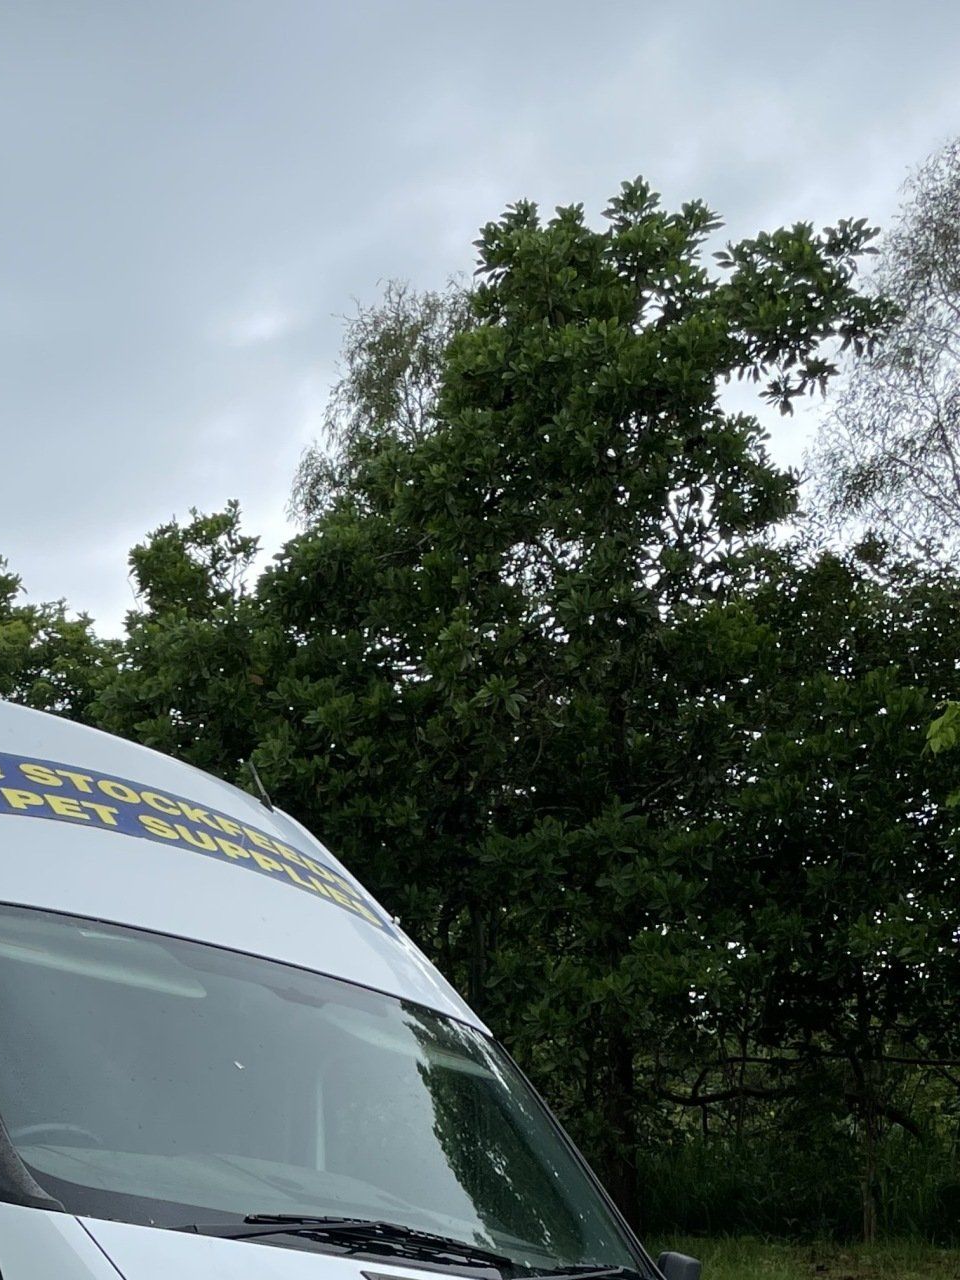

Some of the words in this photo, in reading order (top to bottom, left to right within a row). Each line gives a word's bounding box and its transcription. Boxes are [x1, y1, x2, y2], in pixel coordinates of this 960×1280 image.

[0, 788, 120, 826] PET
[138, 815, 383, 926] SUPPLIES
[19, 763, 362, 900] STOCKFEEDS
